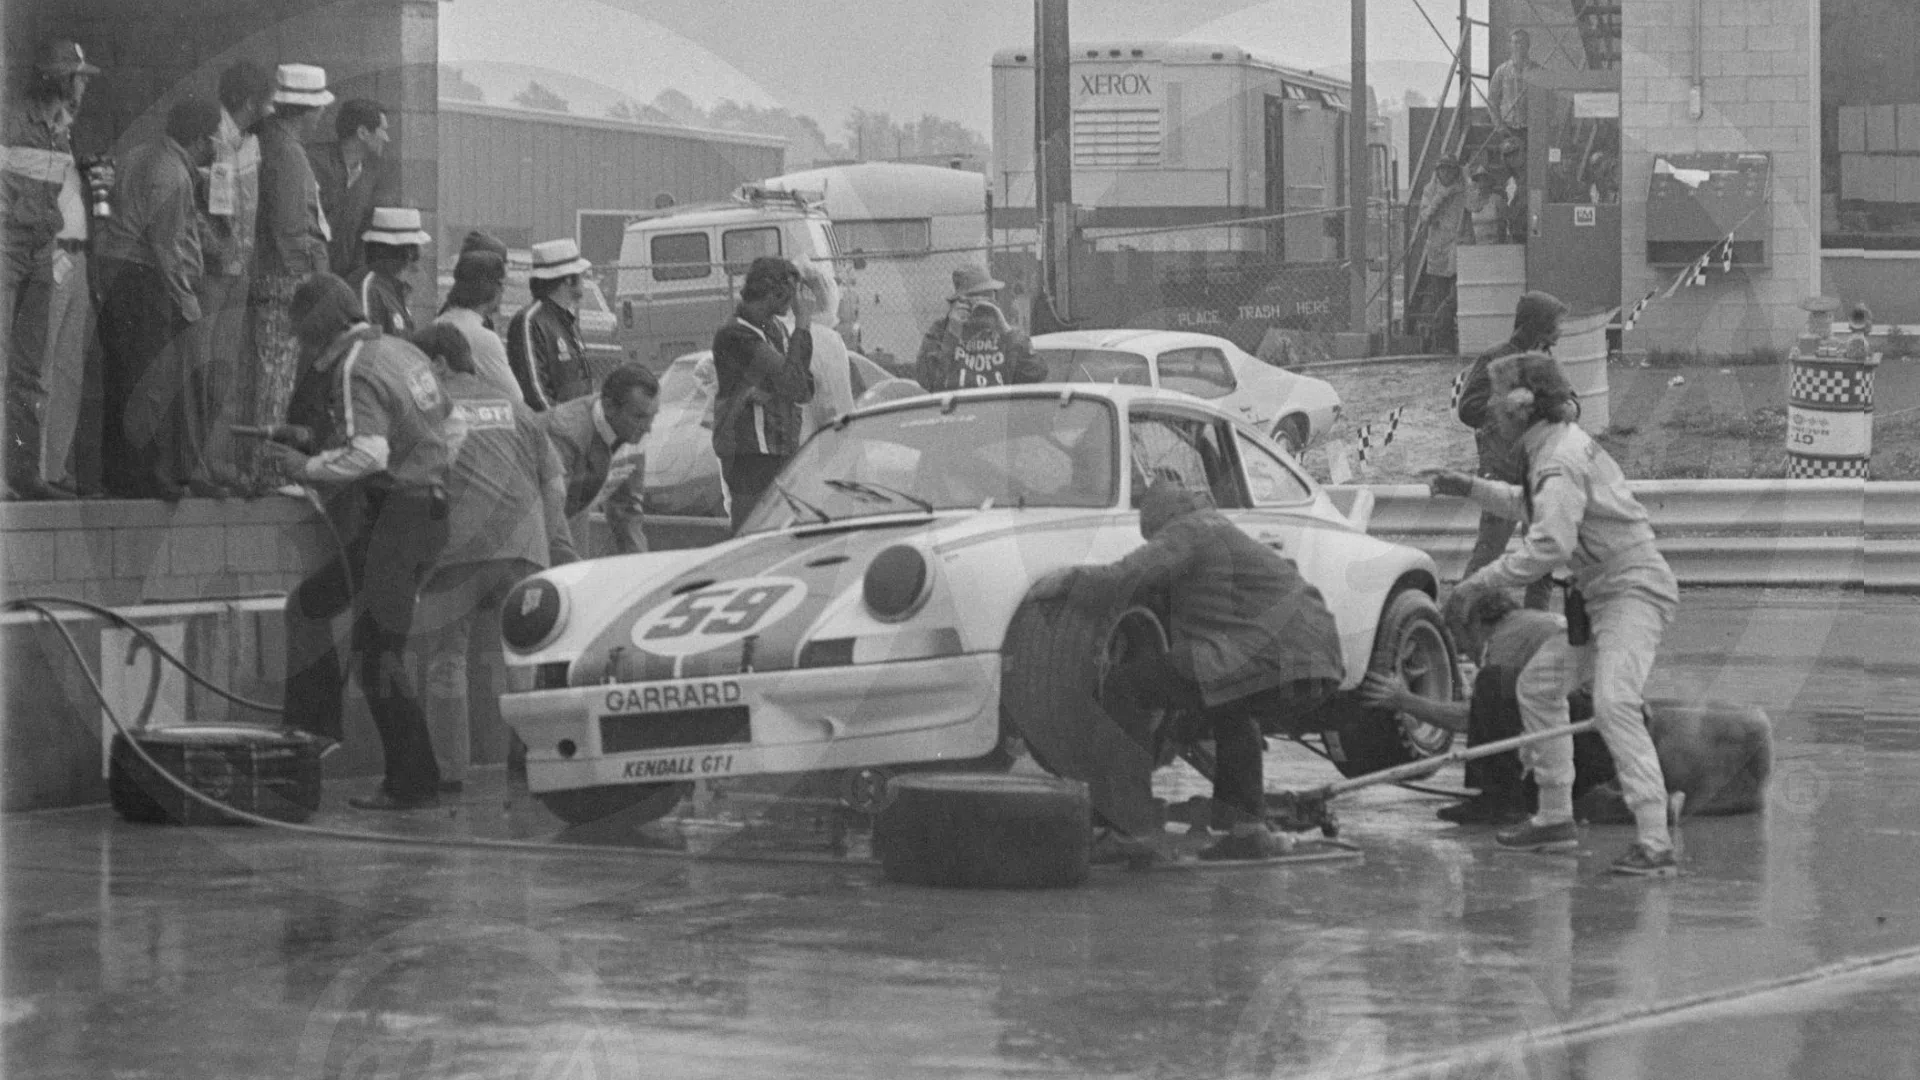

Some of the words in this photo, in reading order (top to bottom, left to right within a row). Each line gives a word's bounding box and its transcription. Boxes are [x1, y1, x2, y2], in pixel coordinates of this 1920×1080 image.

[1080, 73, 1152, 96] XEROX
[1178, 309, 1219, 326] PLACE
[1239, 304, 1281, 320] TRASH
[1296, 299, 1330, 315] HERE
[954, 346, 1005, 372] PHOTO
[643, 585, 795, 639] 59
[605, 680, 741, 712] GARRARD
[623, 757, 694, 778] KENDALL
